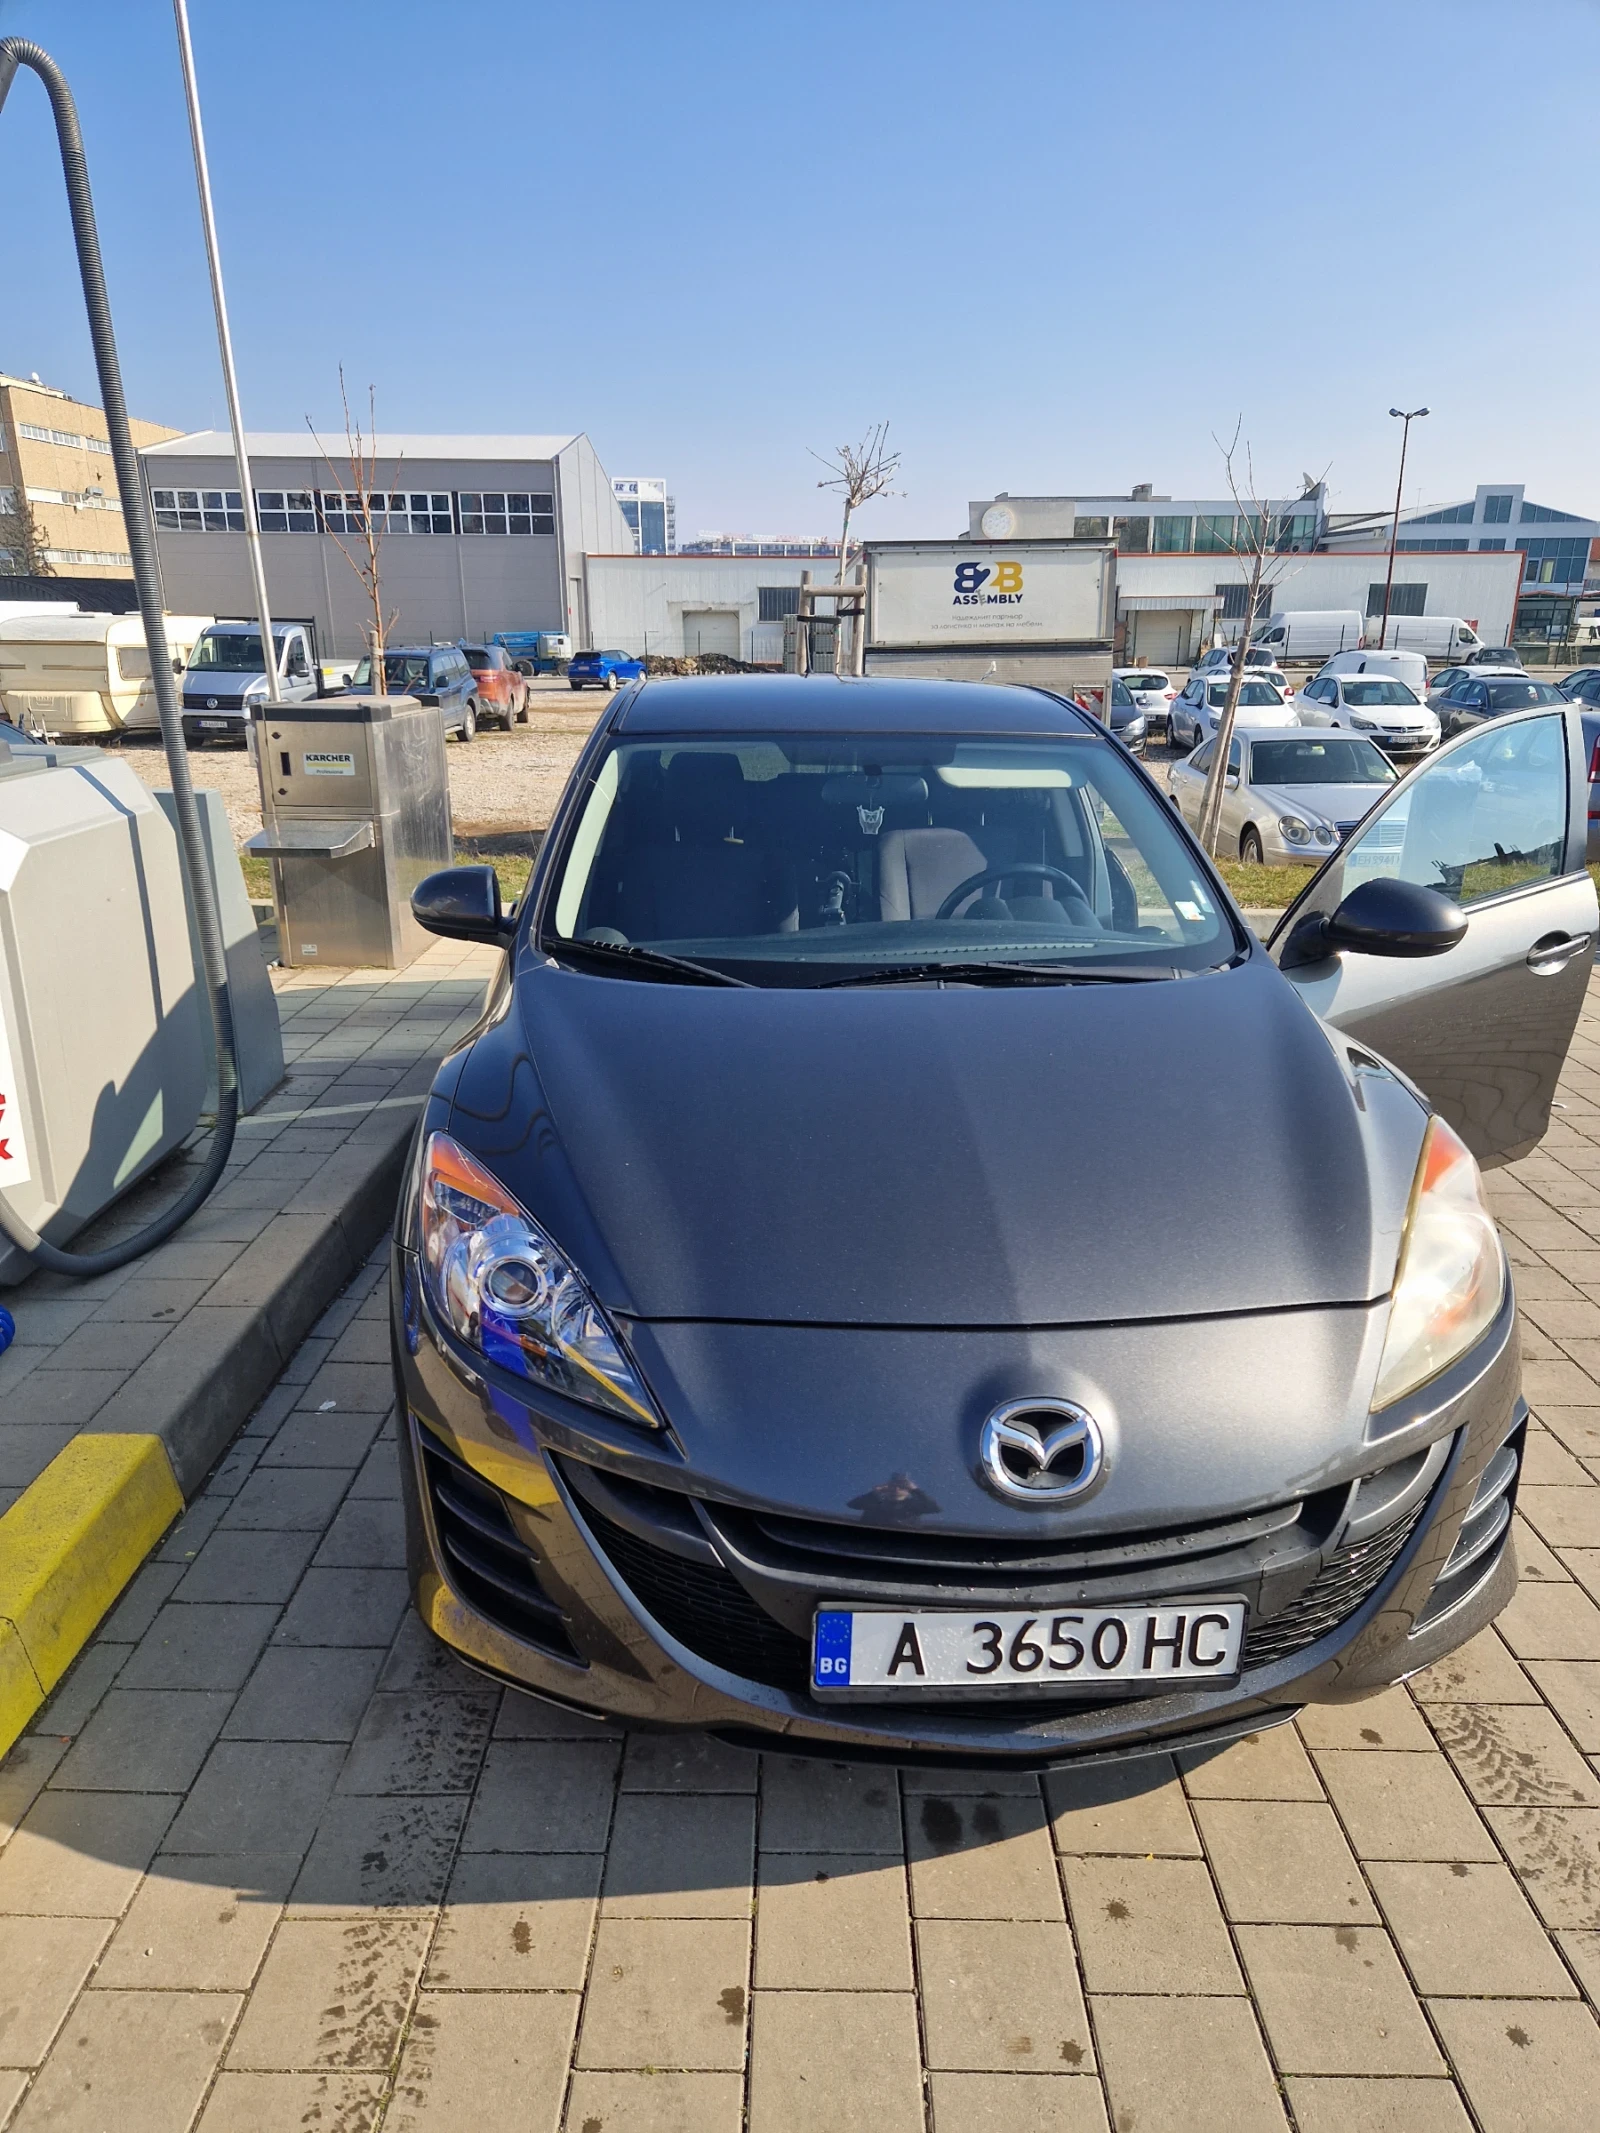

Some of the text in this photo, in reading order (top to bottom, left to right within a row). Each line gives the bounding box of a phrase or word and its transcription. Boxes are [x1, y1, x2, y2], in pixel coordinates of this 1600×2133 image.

[952, 592, 1023, 606] ASSEMBLY
[887, 1613, 1230, 1676] A 3650 HC
[820, 1656, 848, 1674] BG
